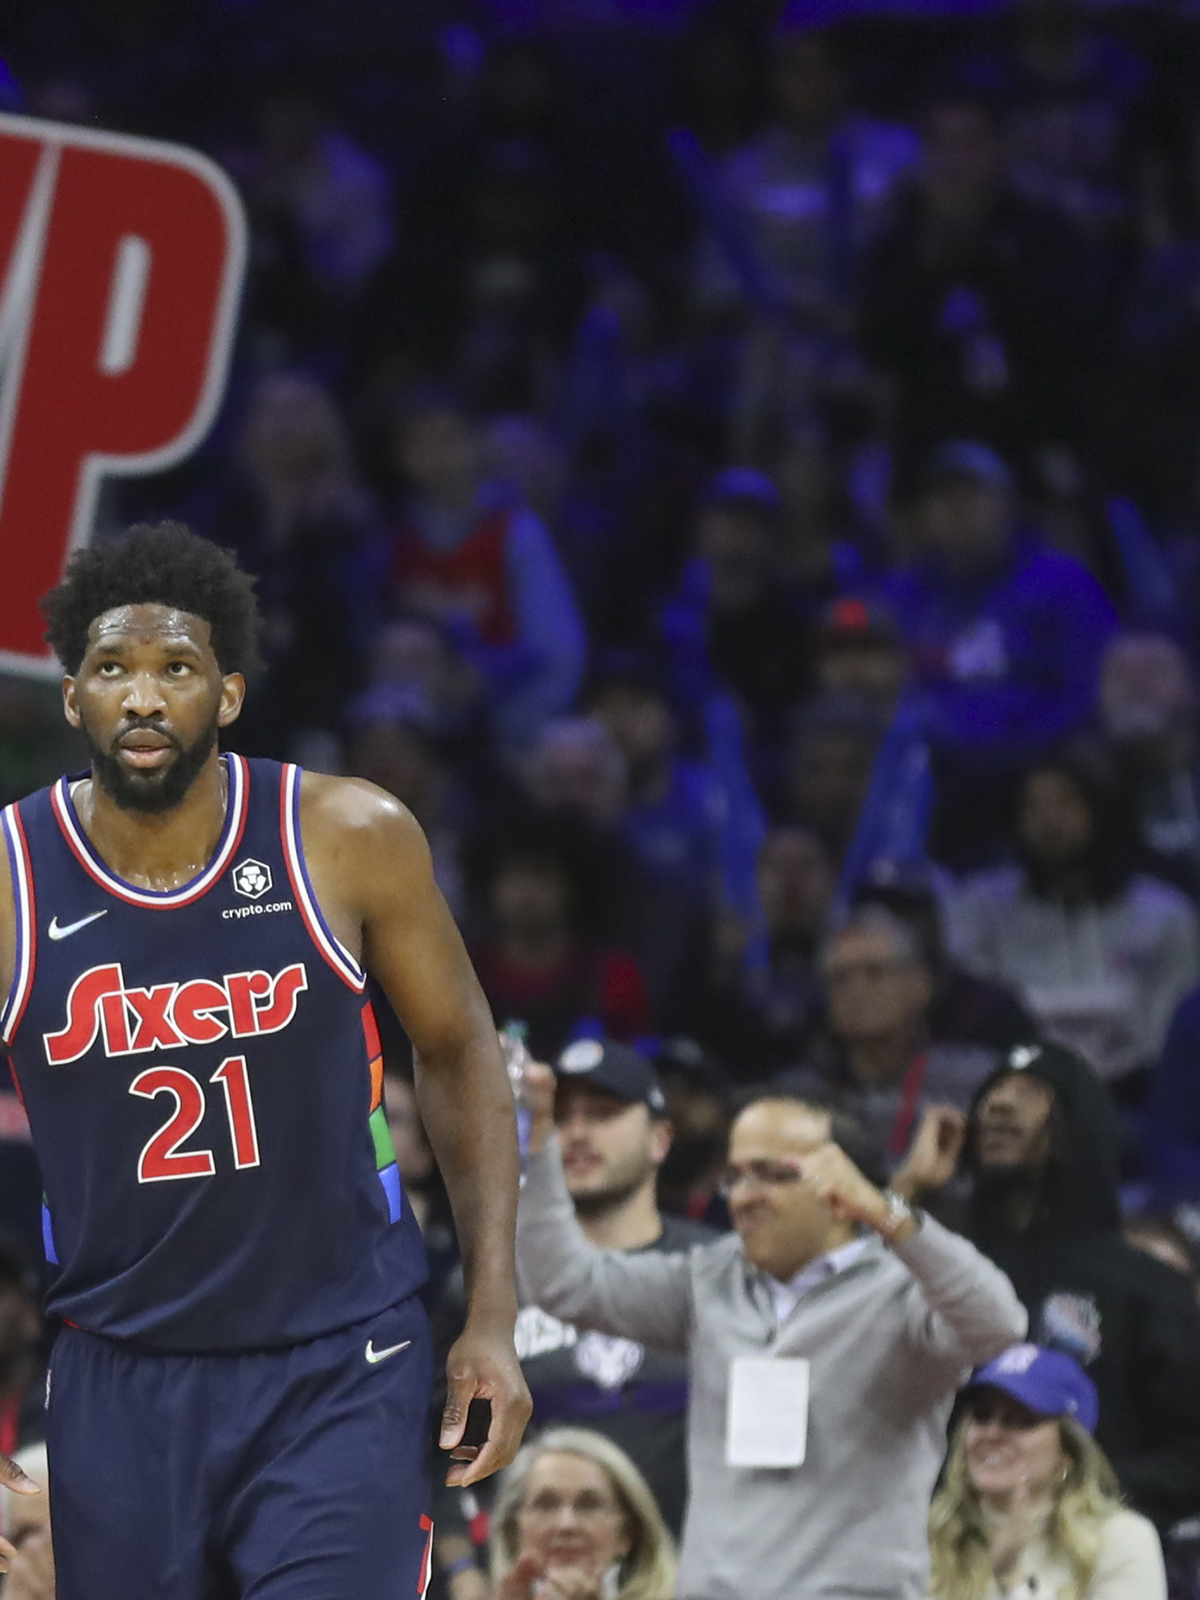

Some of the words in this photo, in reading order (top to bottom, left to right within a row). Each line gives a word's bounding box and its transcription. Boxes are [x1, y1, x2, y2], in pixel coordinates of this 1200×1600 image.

[222, 901, 292, 919] crypto.com
[43, 962, 307, 1065] Sixers
[129, 1055, 260, 1184] 21
